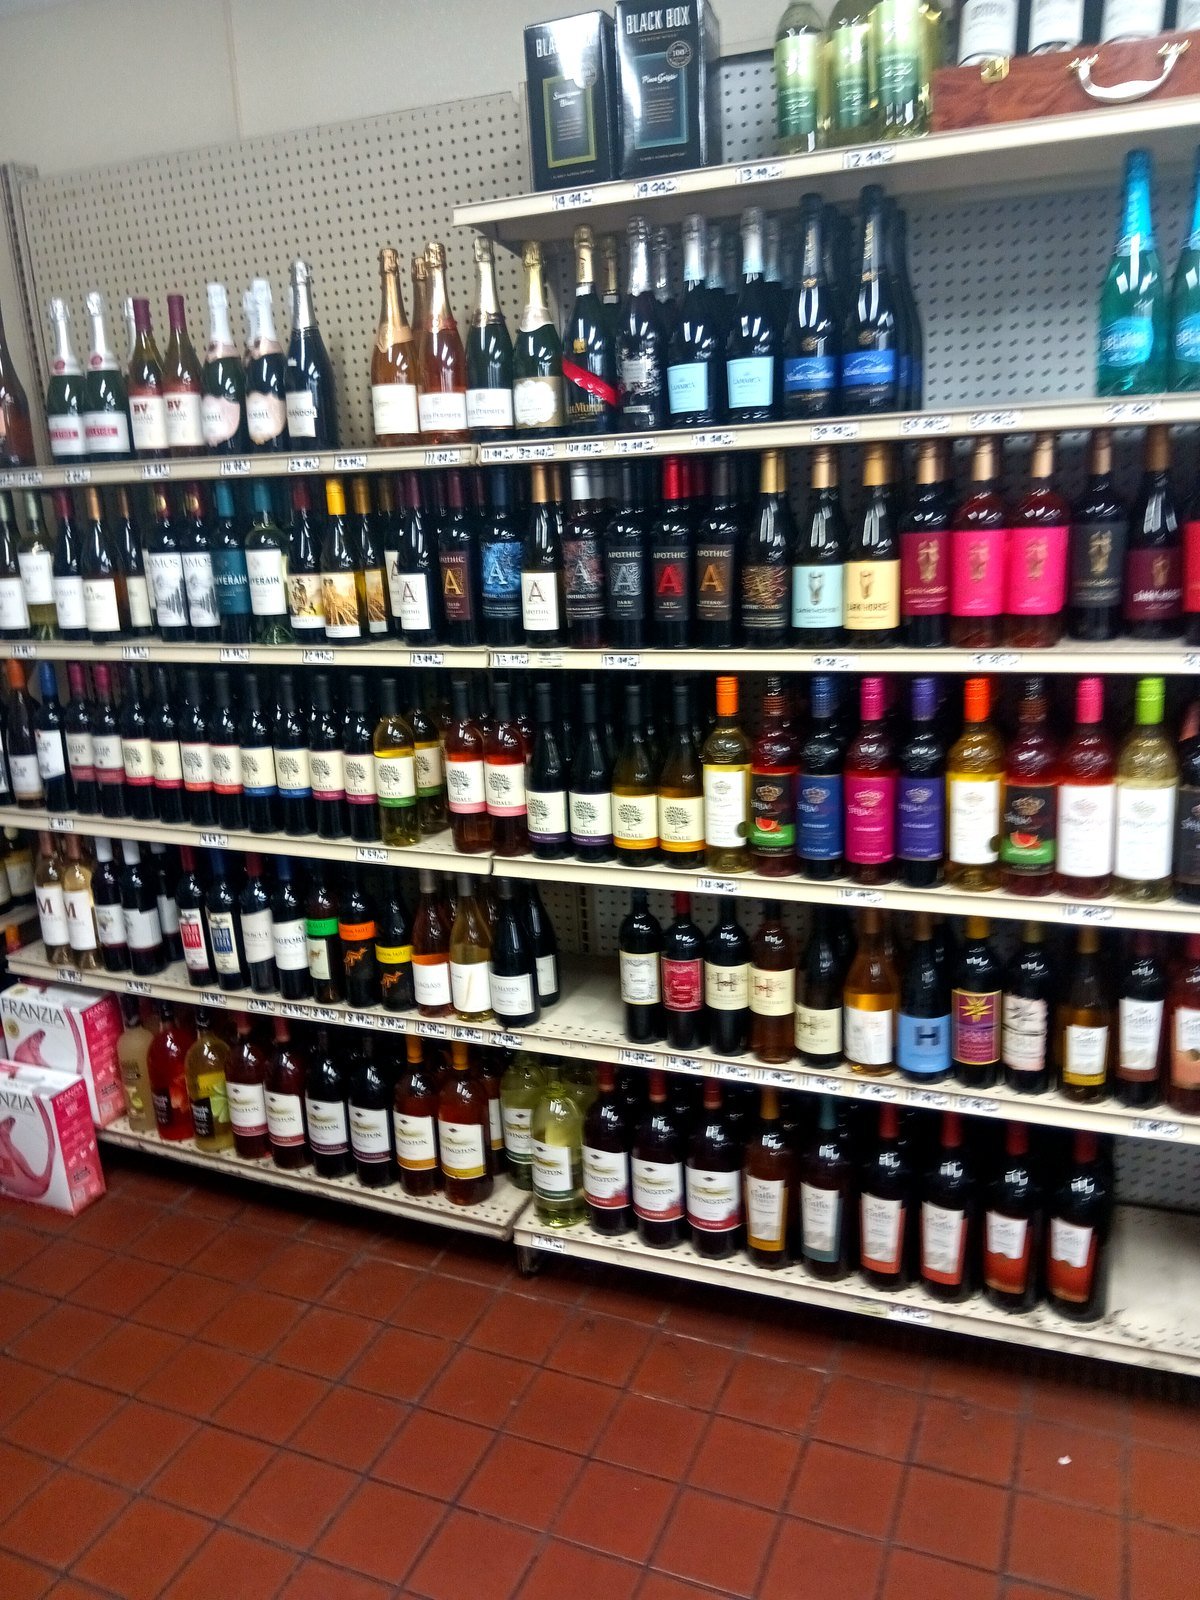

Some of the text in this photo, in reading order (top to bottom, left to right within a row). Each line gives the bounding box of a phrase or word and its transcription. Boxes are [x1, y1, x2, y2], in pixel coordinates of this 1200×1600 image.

[626, 5, 691, 35] BLACK BOX
[133, 402, 149, 416] BV
[166, 399, 182, 412] BV
[608, 551, 641, 559] APOTHIC
[653, 551, 687, 559] APOTHIC
[697, 550, 731, 558] APOTHIC
[444, 570, 463, 595] A
[658, 564, 682, 593] A
[701, 563, 724, 593] A
[402, 581, 417, 603] A
[528, 580, 546, 602] A
[1, 1001, 65, 1027] FRANZIA
[914, 1023, 941, 1047] H
[0, 1091, 35, 1113] NZIA
